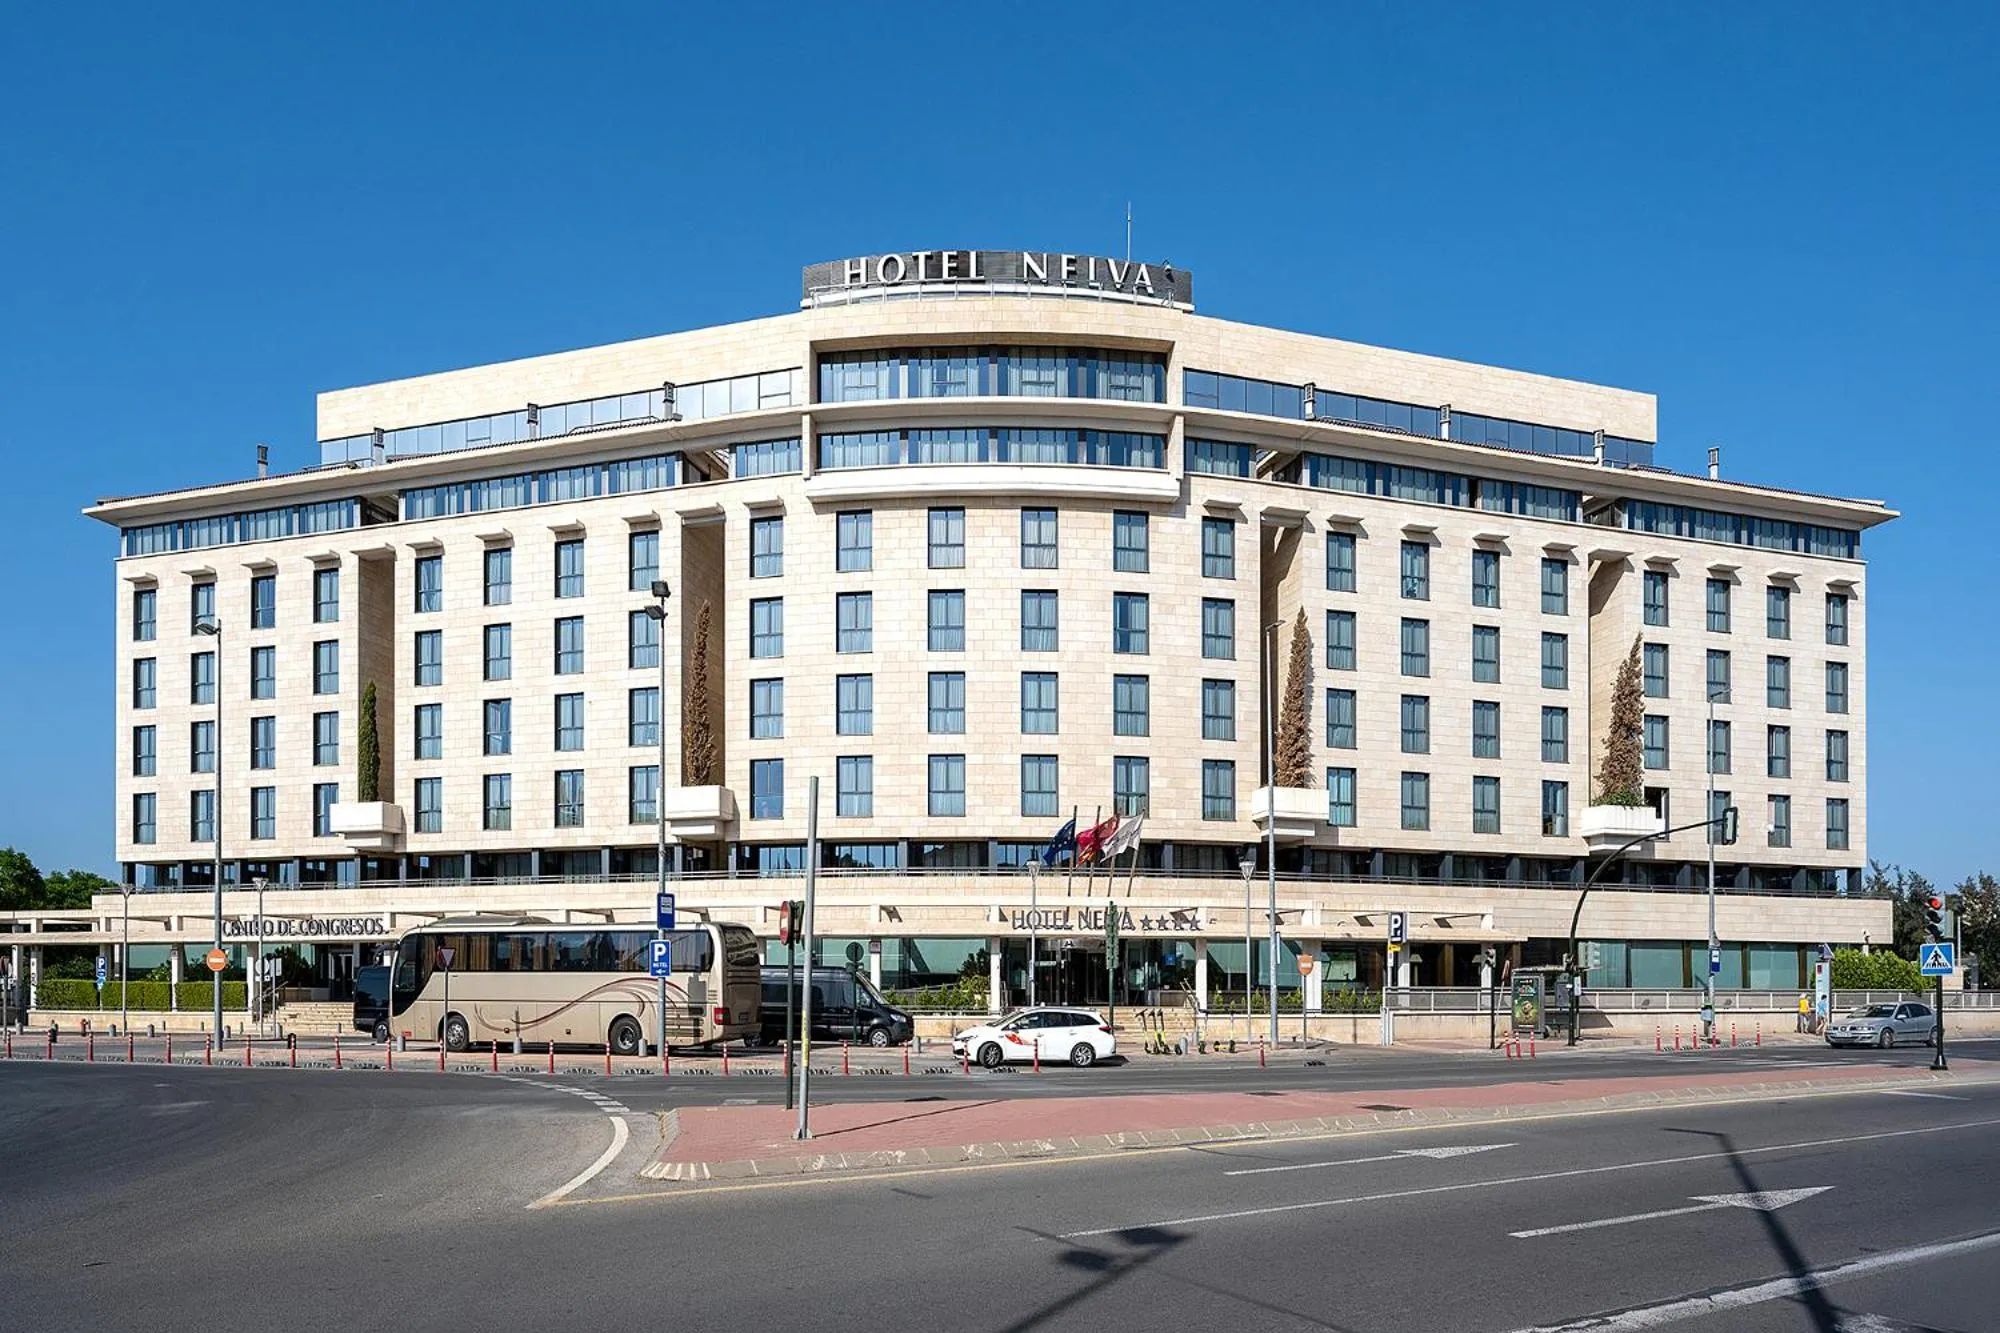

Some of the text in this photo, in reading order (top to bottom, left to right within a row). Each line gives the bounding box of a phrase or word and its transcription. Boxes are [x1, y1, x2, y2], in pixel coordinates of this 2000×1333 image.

[844, 250, 1155, 294] HOTEL NELVA
[277, 919, 296, 936] DE
[300, 917, 384, 936] CONGRESOS
[1012, 910, 1073, 930] HOTEL
[1391, 914, 1402, 937] P
[654, 943, 667, 962] P
[98, 958, 105, 969] P
